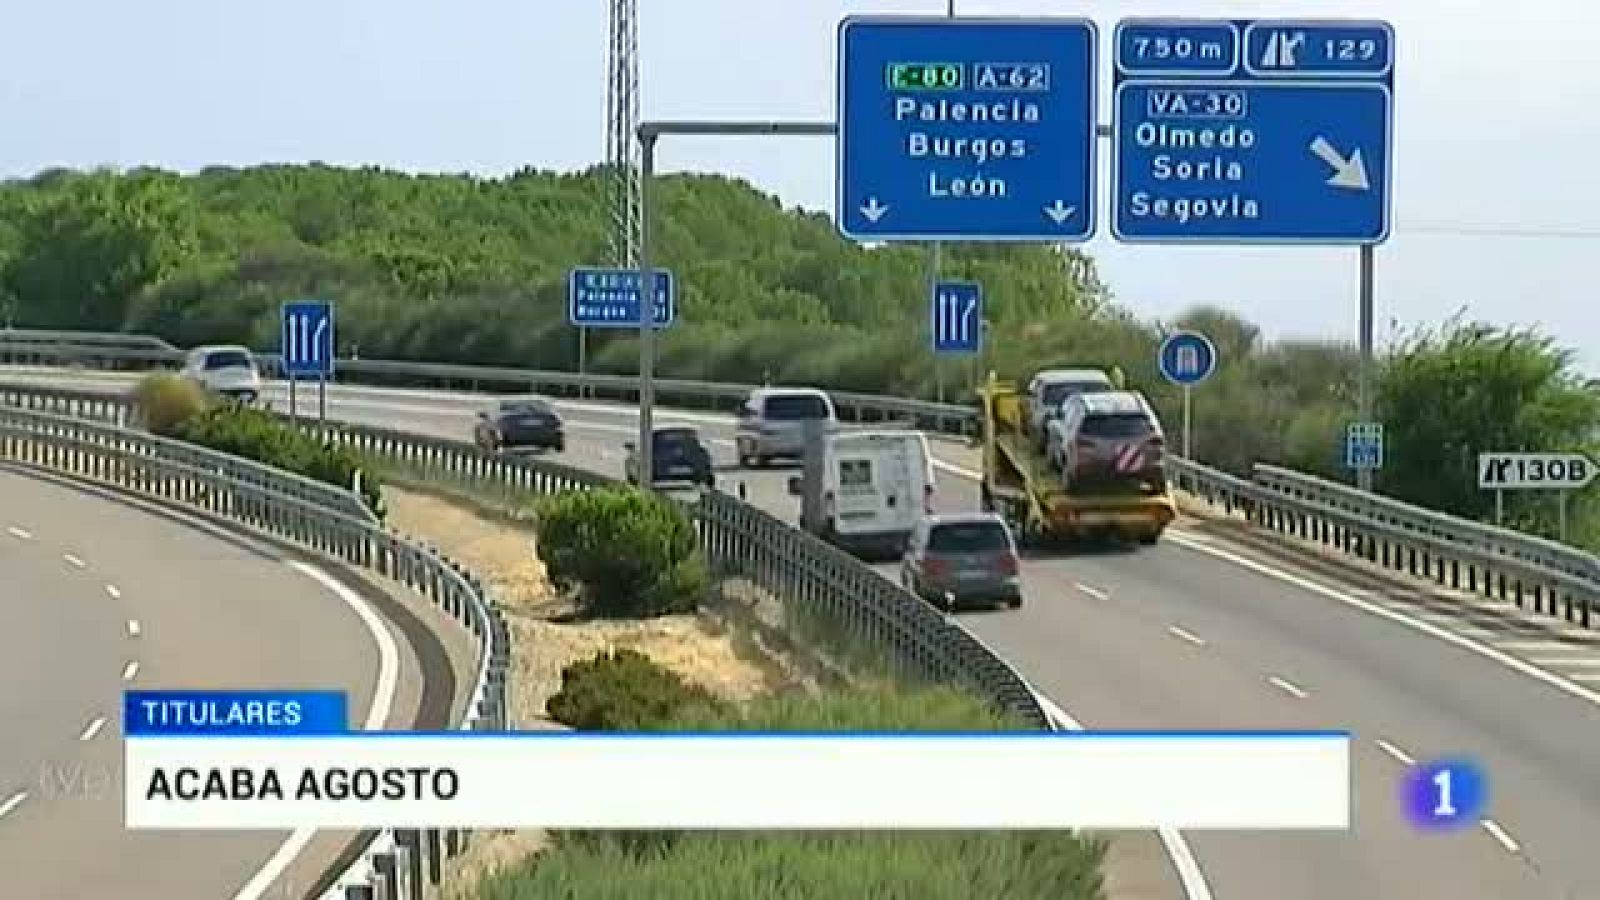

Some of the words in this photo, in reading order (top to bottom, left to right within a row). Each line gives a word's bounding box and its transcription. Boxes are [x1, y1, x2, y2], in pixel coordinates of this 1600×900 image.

[1133, 37, 1191, 59] 750
[1201, 41, 1221, 59] m
[1326, 39, 1376, 60] 129
[979, 65, 1045, 89] A-62
[895, 97, 1040, 121] Palencia
[1152, 92, 1242, 114] VA-30
[1135, 122, 1255, 148] Olmedo
[908, 132, 1026, 164] Burgos
[1152, 154, 1242, 180] Soria
[929, 171, 1006, 197] León
[1130, 192, 1259, 223] Segovia
[1518, 459, 1586, 482] 130B
